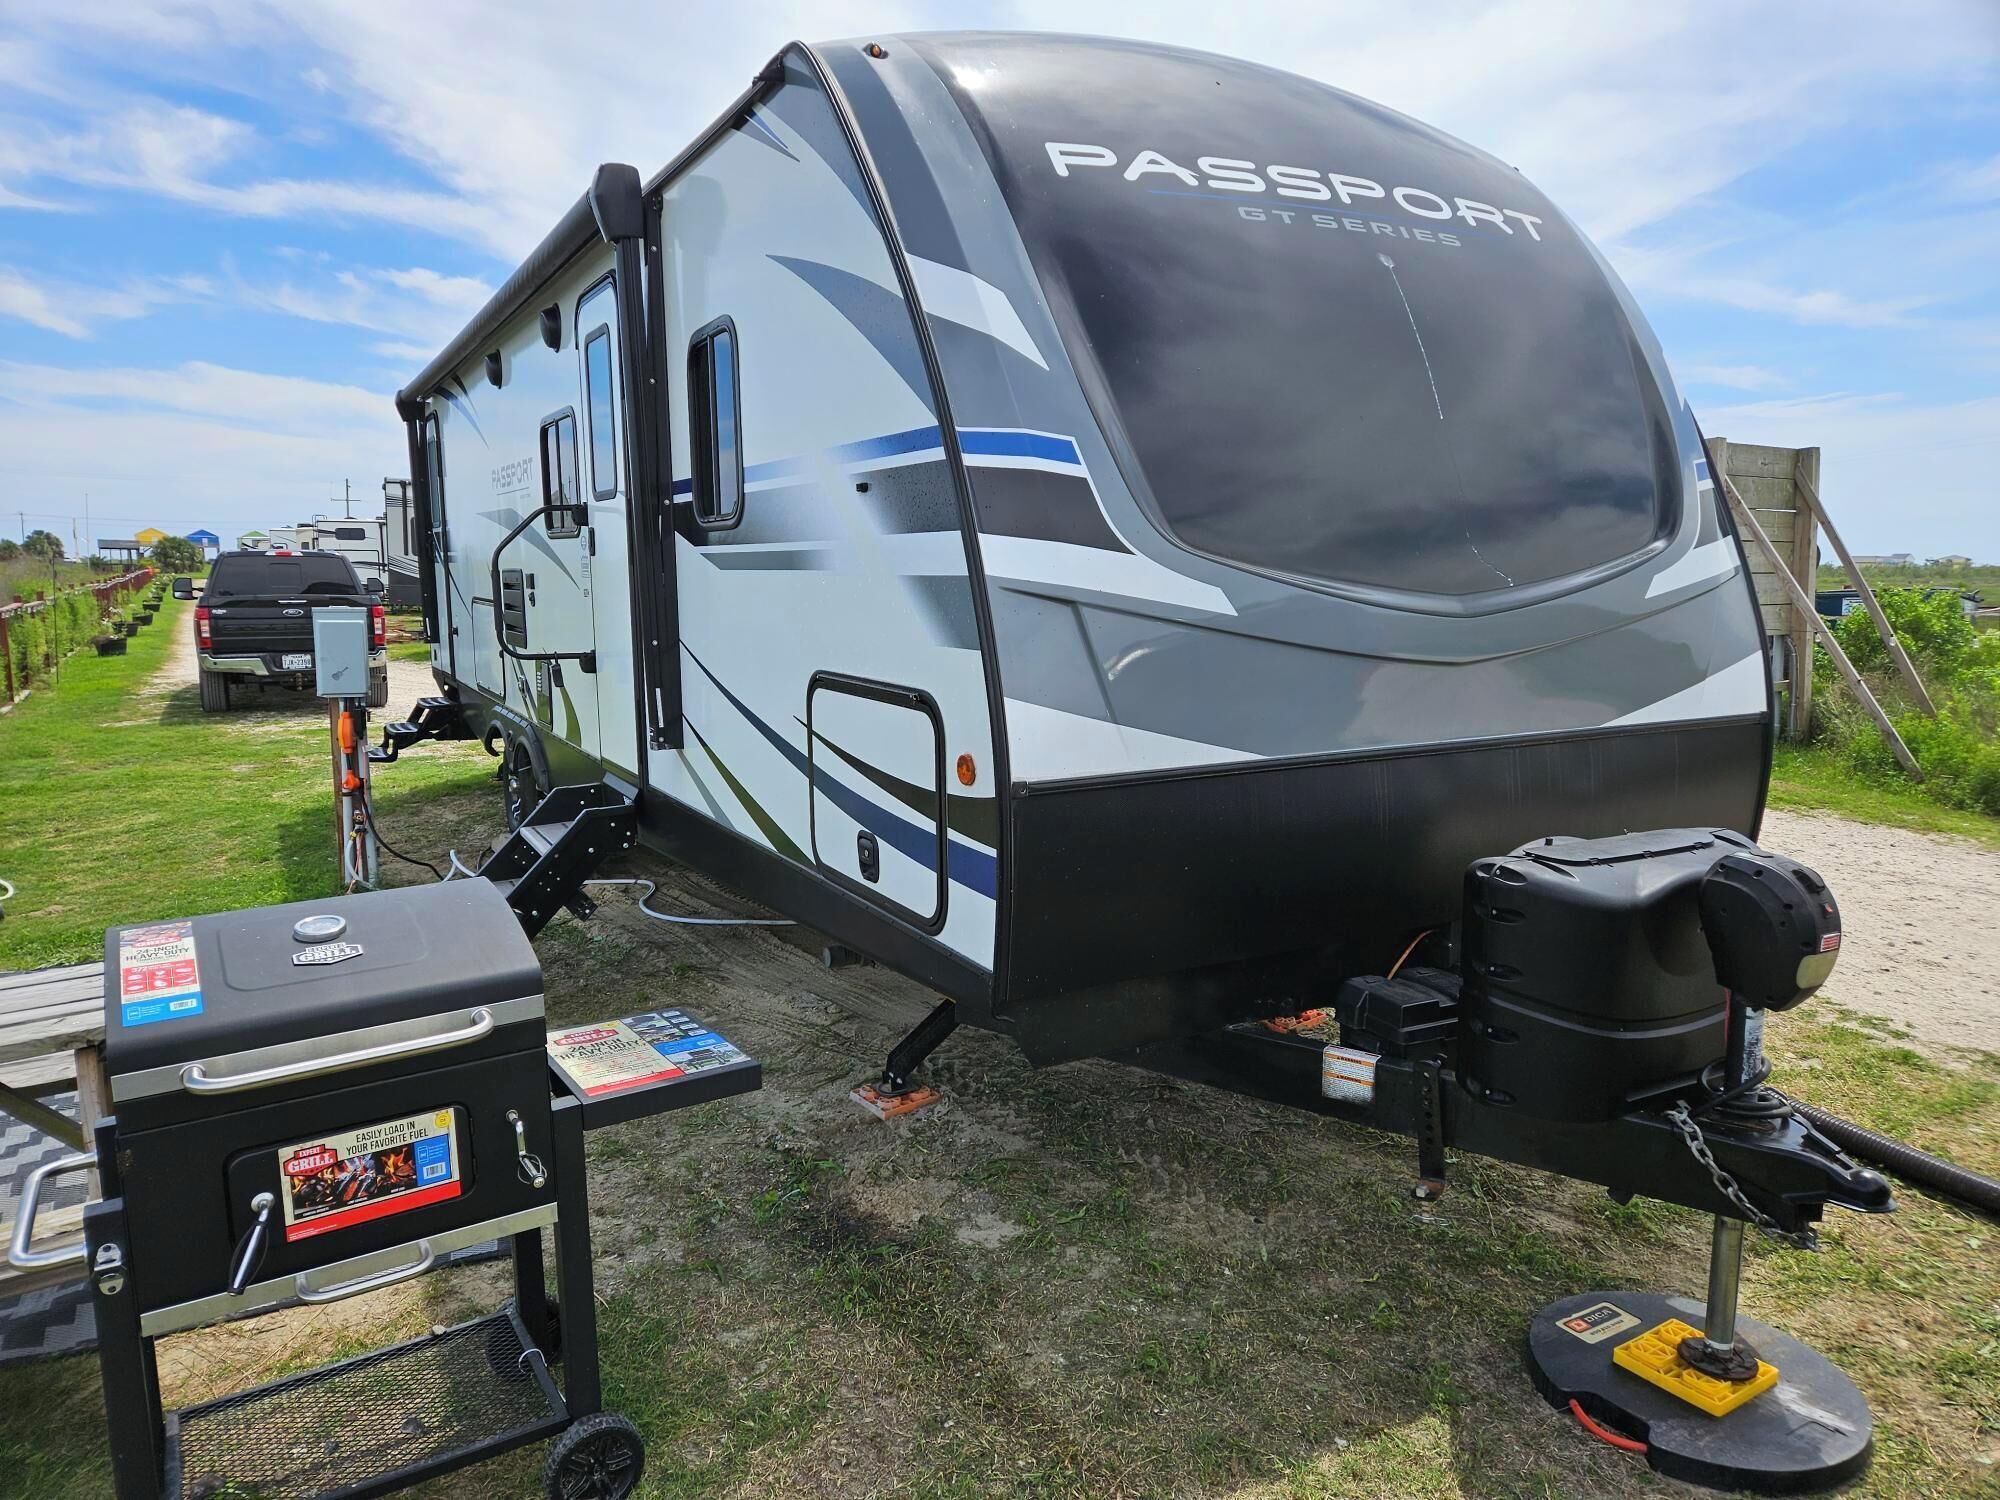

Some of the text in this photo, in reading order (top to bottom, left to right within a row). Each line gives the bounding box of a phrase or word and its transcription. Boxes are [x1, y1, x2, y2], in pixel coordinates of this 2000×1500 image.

[1044, 141, 1543, 242] PASSPORT
[1238, 206, 1463, 248] GT SERIES
[491, 457, 533, 489] PASSPORT
[126, 947, 190, 961] HEAVY-DUTY
[136, 944, 178, 954] 24-INCH
[559, 1040, 640, 1060] HEAVY-DUTY
[568, 1038, 622, 1053] 24-INCH
[356, 1120, 416, 1143] EASILY LOAD IN
[300, 1147, 320, 1157] EXPERT
[346, 1128, 429, 1156] YOUR FAVORITE FUEL
[288, 1153, 334, 1173] GRILL
[1584, 1309, 1613, 1322] DICA
